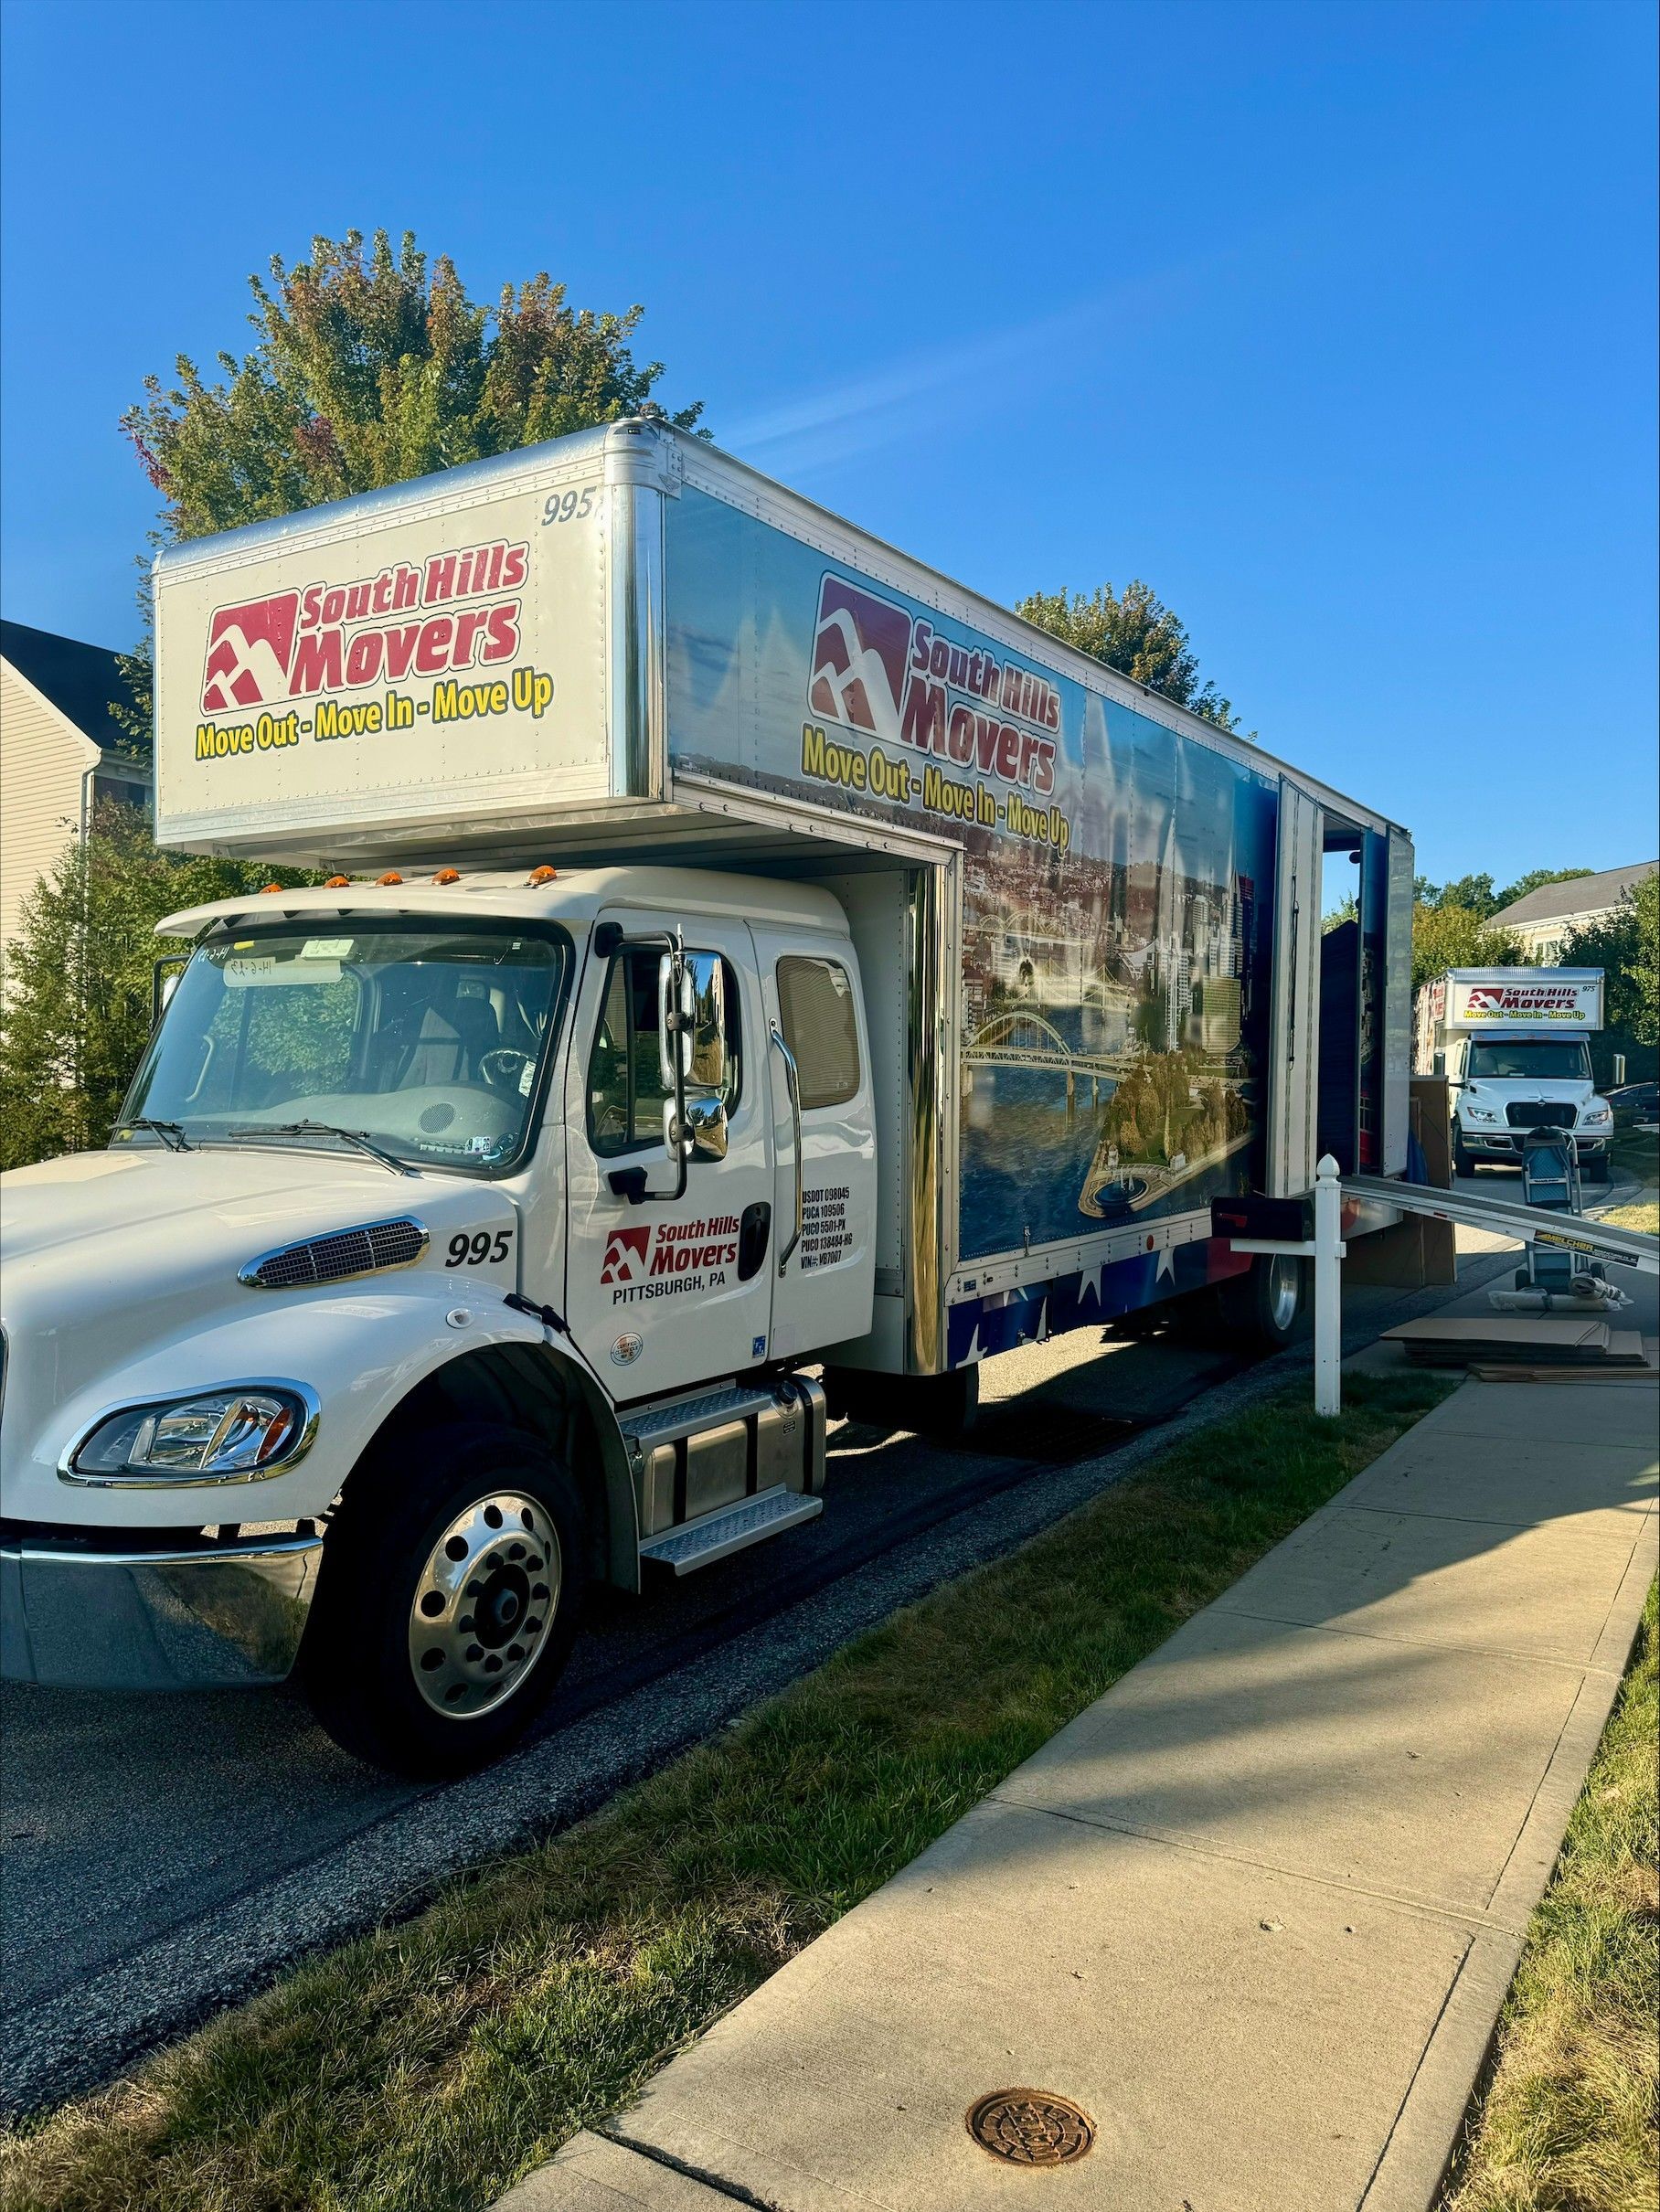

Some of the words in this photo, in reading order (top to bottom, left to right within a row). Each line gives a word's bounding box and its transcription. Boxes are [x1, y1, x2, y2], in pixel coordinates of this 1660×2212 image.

[541, 485, 597, 526] 995
[302, 567, 421, 629] South
[424, 544, 528, 602] Hills
[288, 602, 520, 696] Movers
[910, 622, 1001, 707] South
[1003, 659, 1061, 730] Hills
[195, 722, 254, 762] Move
[256, 713, 300, 751] Out
[301, 719, 313, 734] -
[314, 698, 385, 742] Move
[386, 692, 412, 733] In
[418, 702, 428, 718] -
[433, 680, 507, 725] Move
[512, 667, 554, 718] Up
[900, 675, 1056, 794] Movers
[802, 725, 867, 789] Move
[868, 746, 910, 803] Out
[912, 779, 921, 793] -
[923, 764, 974, 819] Move
[977, 780, 996, 828] In
[1006, 792, 1048, 843] Move
[1048, 804, 1069, 858] Up
[1500, 996, 1576, 1009] Movers
[1504, 988, 1547, 997] South
[1547, 988, 1579, 997] Hills
[1463, 1010, 1486, 1019] Move
[1487, 1010, 1505, 1019] Out
[1509, 1011, 1532, 1019] Move
[1532, 1011, 1543, 1019] In
[1548, 1011, 1572, 1019] Move
[1572, 1011, 1586, 1021] Up
[802, 1189, 824, 1204] USDOT
[802, 1206, 820, 1219] PUCA
[820, 1203, 846, 1218] 109506
[655, 1218, 706, 1244] South
[707, 1216, 740, 1237] Hills
[801, 1238, 819, 1252] PUCO
[802, 1221, 820, 1237] PUCO
[444, 1230, 513, 1268] 995
[649, 1242, 738, 1276] Movers
[612, 1274, 705, 1305] PITTSBURGH,
[709, 1271, 726, 1287] PA
